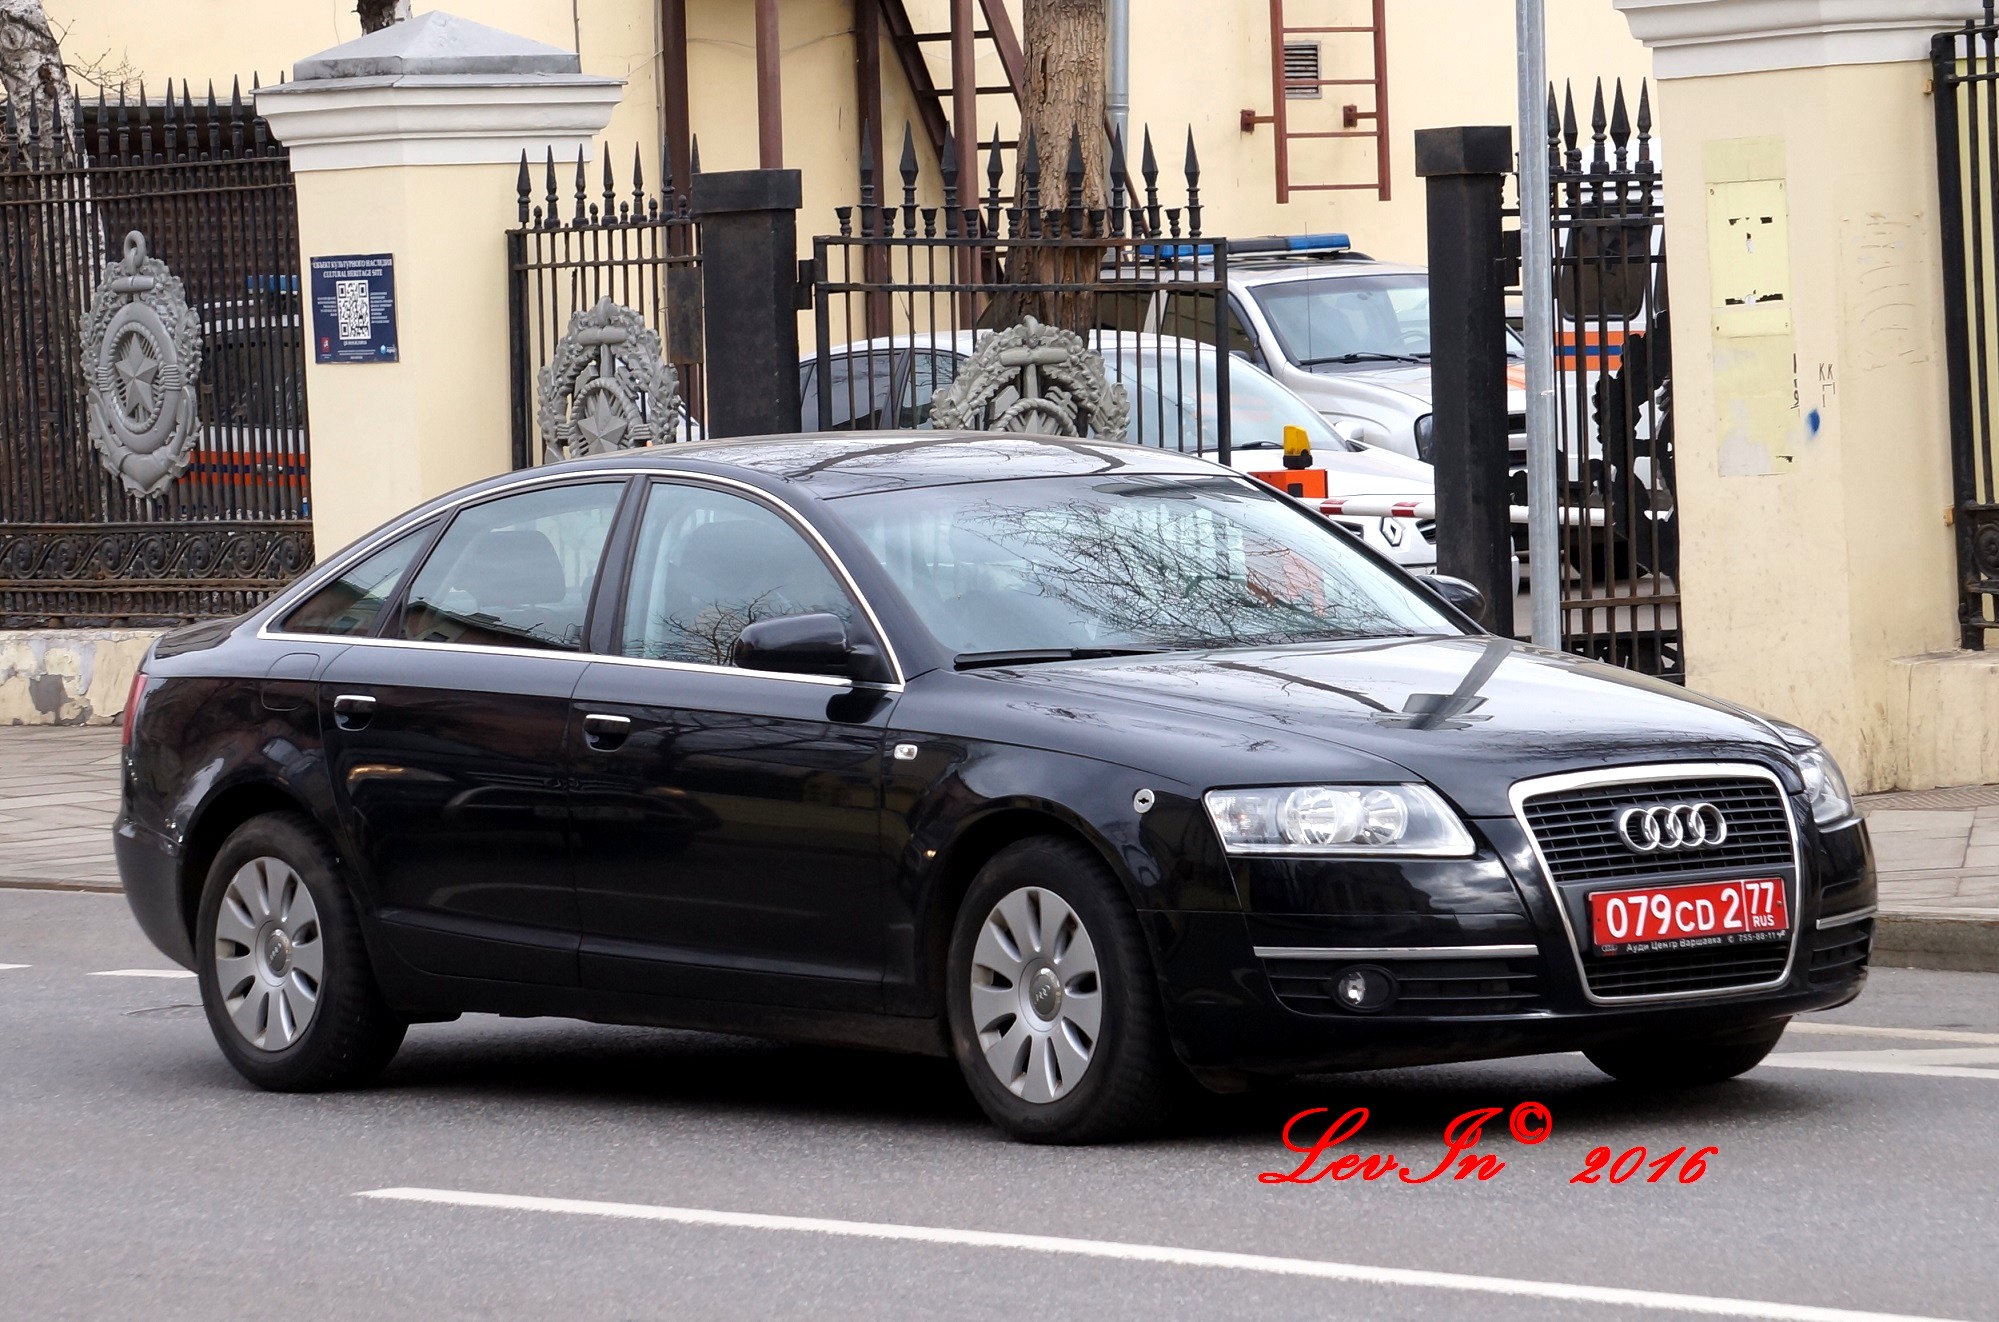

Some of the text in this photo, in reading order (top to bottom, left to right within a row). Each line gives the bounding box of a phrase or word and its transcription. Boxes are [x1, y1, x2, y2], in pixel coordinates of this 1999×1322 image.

[1745, 882, 1774, 914] 77
[1752, 914, 1775, 928] RUS
[1626, 943, 1650, 953] Ауди
[1650, 940, 1678, 951] Центр
[1679, 936, 1722, 948] Варшавка
